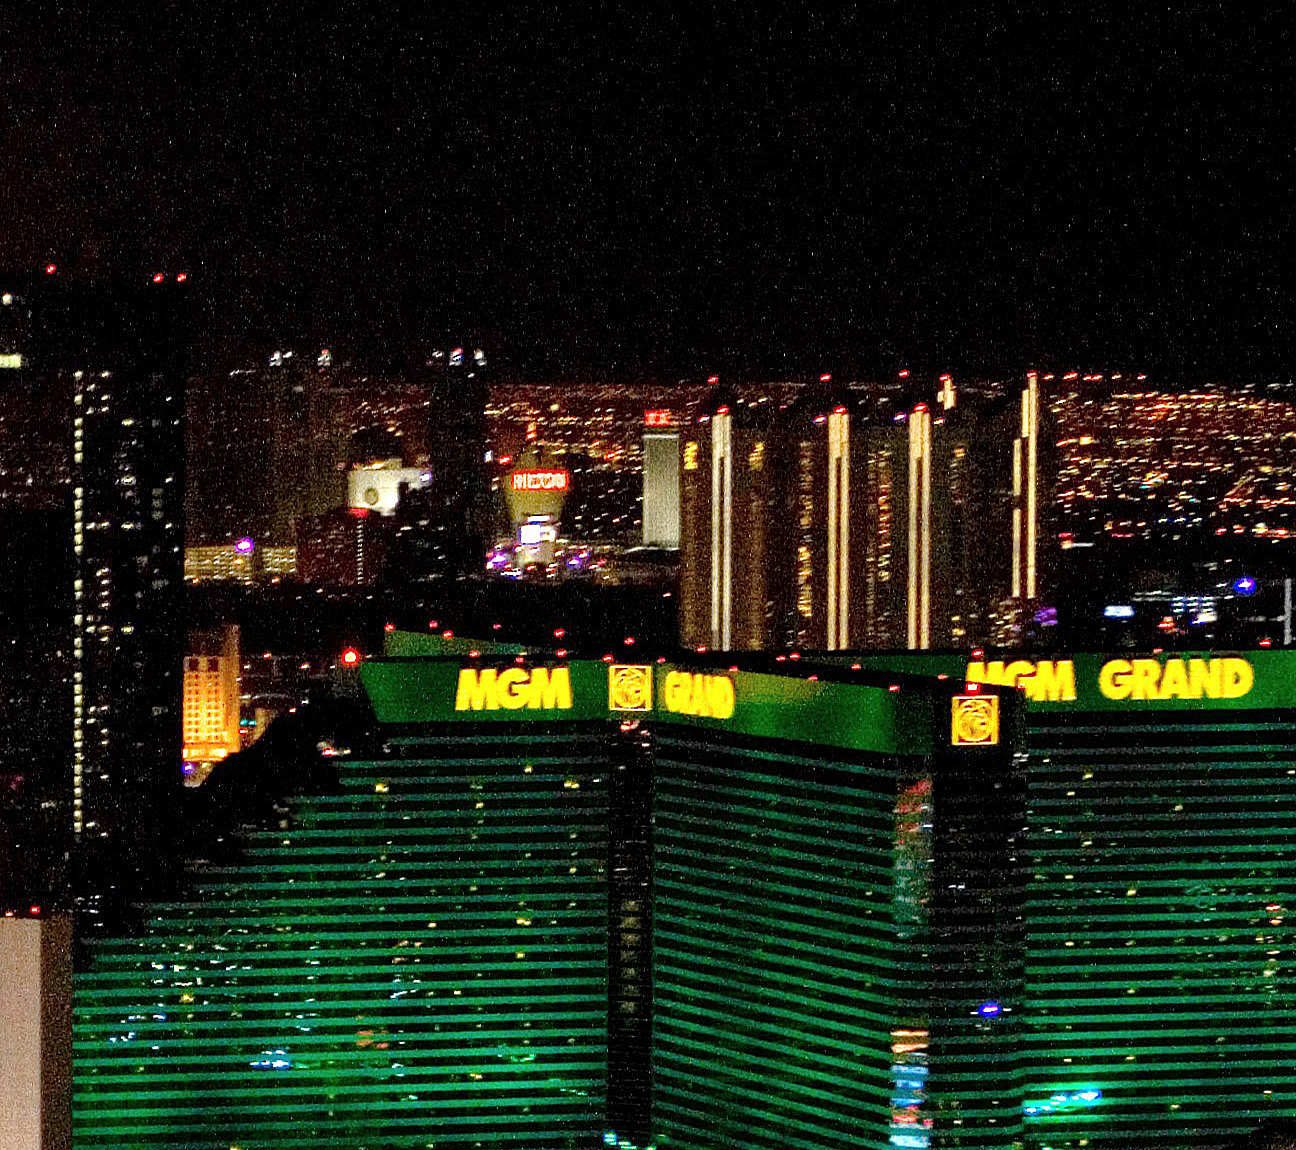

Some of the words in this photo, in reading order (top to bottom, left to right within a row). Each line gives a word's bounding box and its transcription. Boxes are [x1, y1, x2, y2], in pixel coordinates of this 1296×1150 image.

[455, 666, 573, 711] MGM
[664, 671, 735, 719] GRAND
[1098, 658, 1255, 700] GRAND
